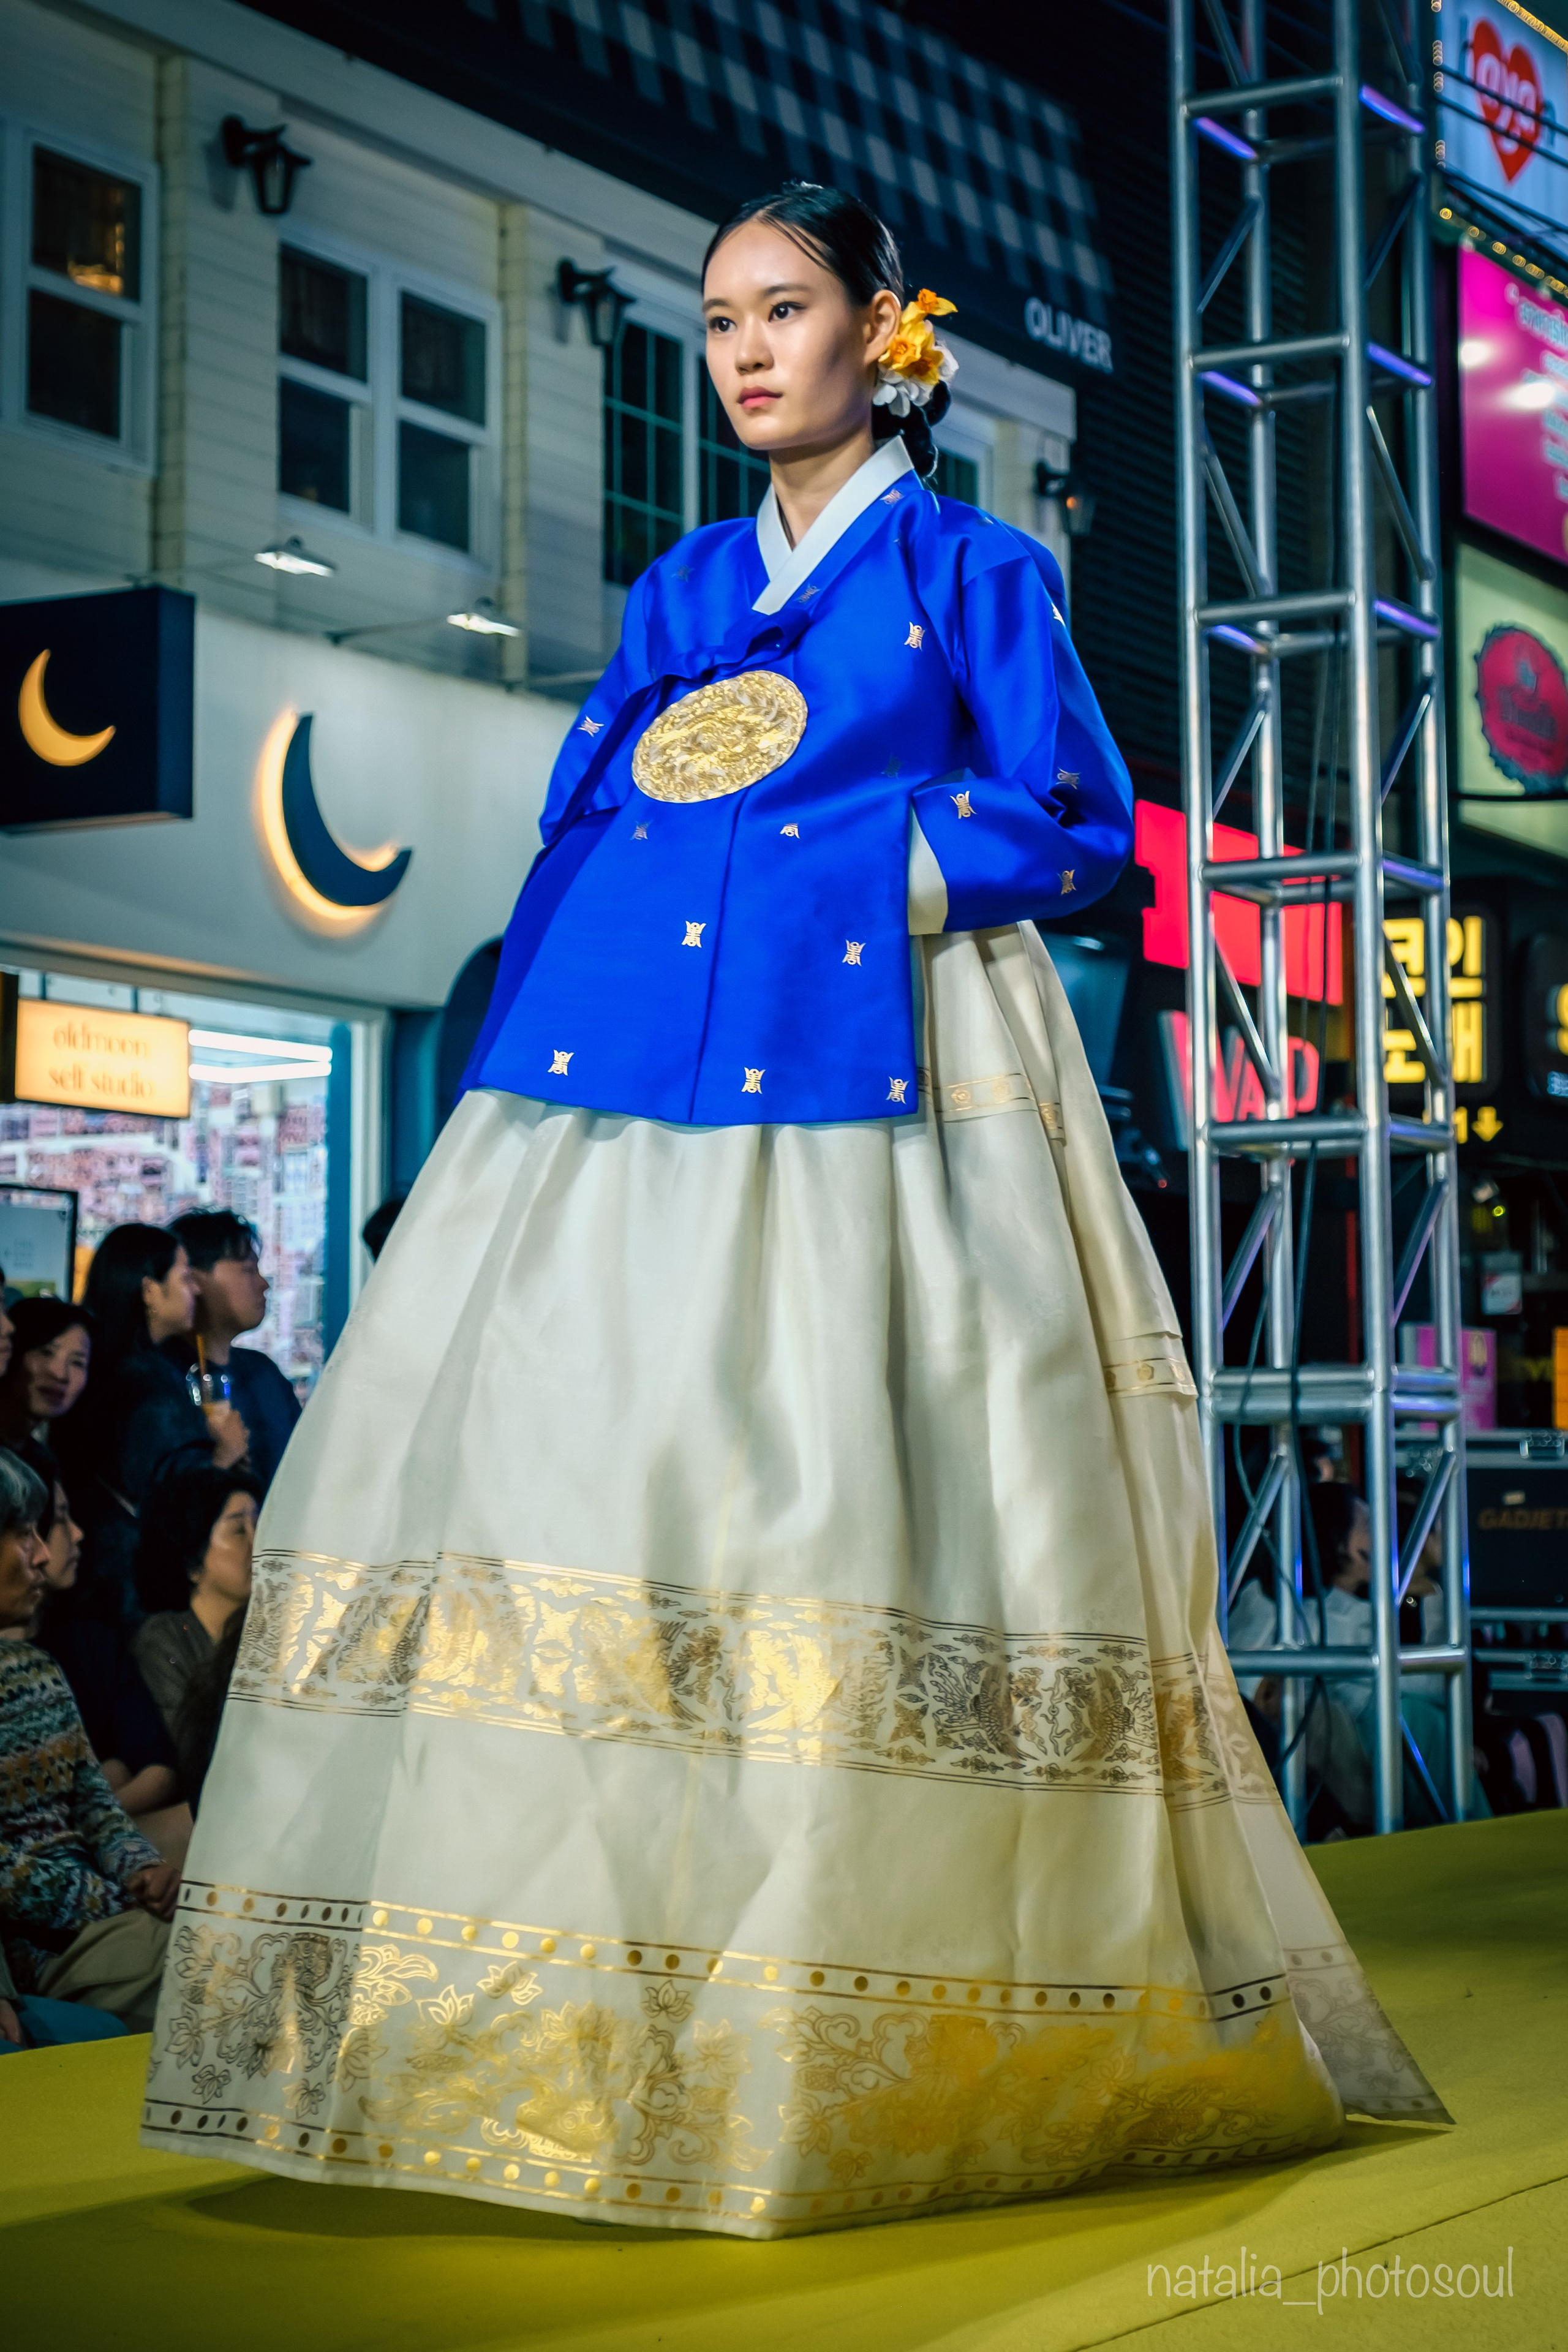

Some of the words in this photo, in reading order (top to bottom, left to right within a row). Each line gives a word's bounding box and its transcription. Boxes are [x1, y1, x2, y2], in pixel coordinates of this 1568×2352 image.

[1025, 296, 1114, 373] OLIVER
[53, 1020, 147, 1058] oldmoon
[49, 1061, 85, 1091] self
[91, 1072, 153, 1099] studio
